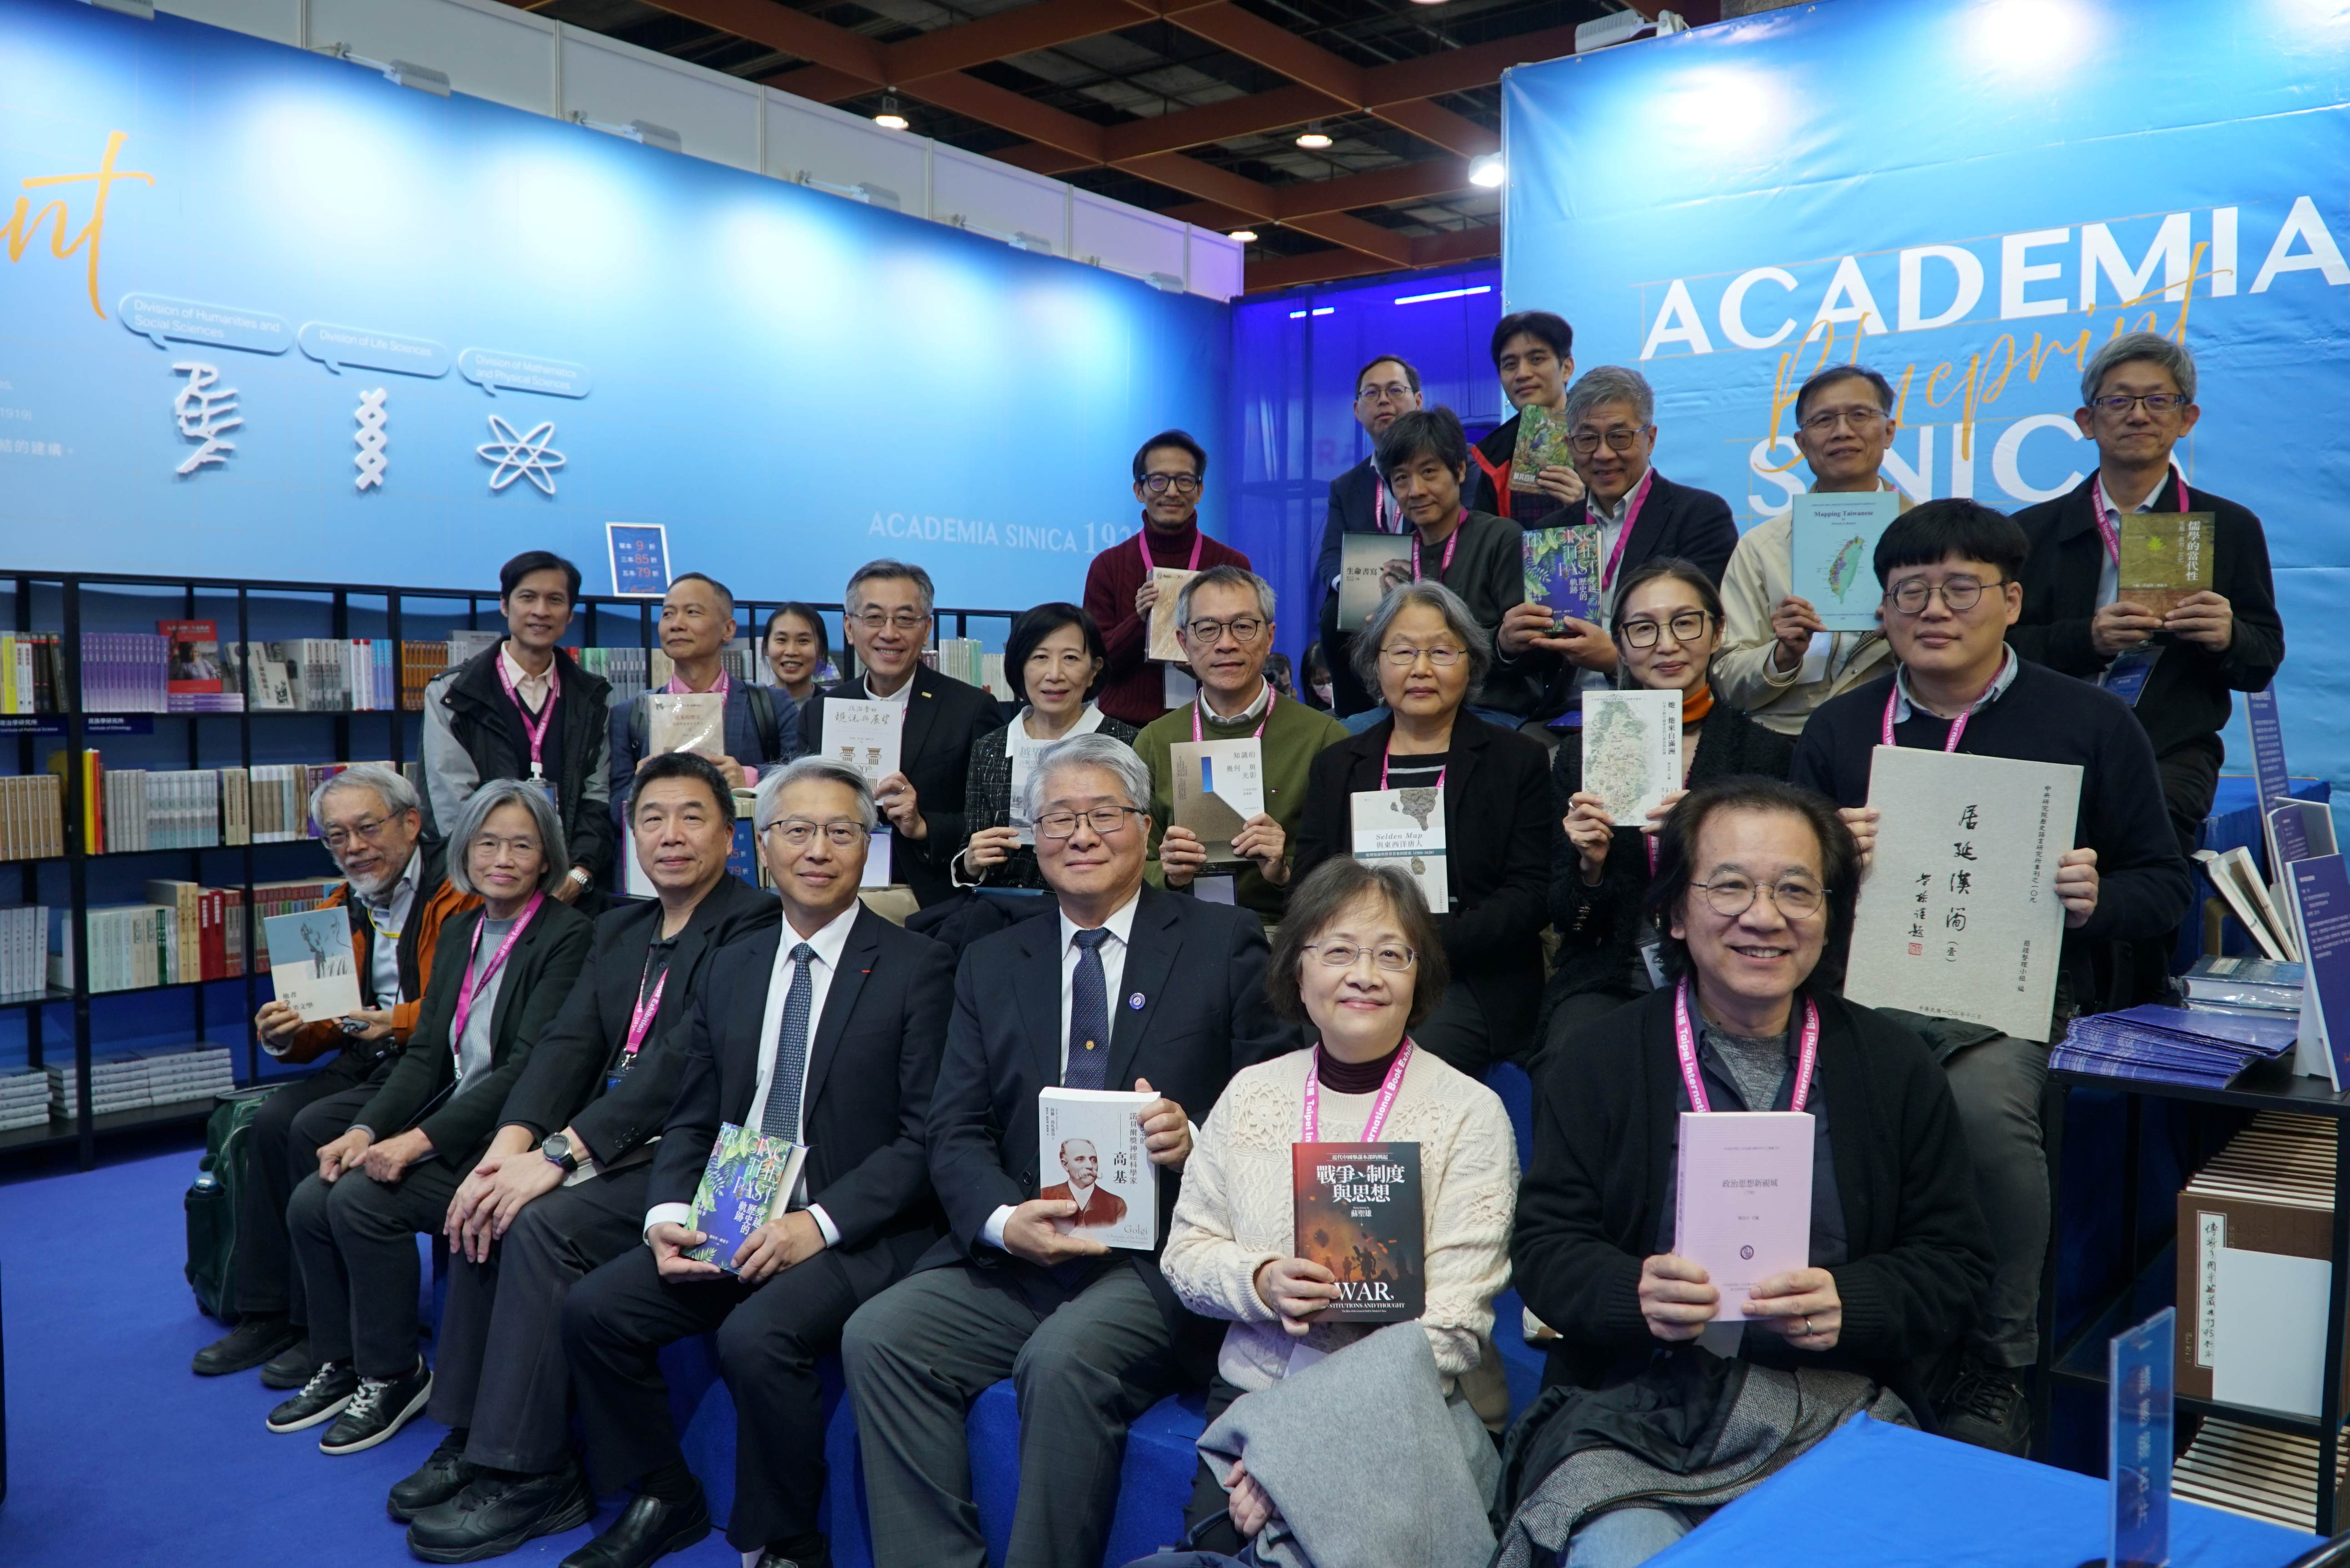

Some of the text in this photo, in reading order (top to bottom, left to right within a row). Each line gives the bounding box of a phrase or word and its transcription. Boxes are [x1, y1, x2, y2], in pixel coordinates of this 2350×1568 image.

[1640, 196, 2350, 361] ACADEMIA
[134, 299, 280, 332] Division of Humanities and
[134, 315, 225, 338] Social Sciences
[319, 329, 432, 357] Division of Life Sciences
[475, 354, 510, 368] Division
[522, 361, 577, 379] Mathematics
[476, 368, 571, 390] and Physical Sciences
[1749, 414, 2190, 517] SNIC
[868, 511, 999, 546] ACADEMIA
[1005, 523, 1078, 553] SINICA
[1523, 526, 1597, 548] TRACING
[636, 540, 644, 551] 9
[1563, 543, 1597, 560] THE
[2186, 521, 2200, 581] 儒學的當代性
[634, 553, 650, 564] 85
[1558, 559, 1597, 577] PAST
[636, 567, 652, 578] 79
[1346, 567, 1379, 576] 生命書寫
[1569, 578, 1578, 595] 軌跡
[1578, 577, 1587, 601] 歷史的
[1233, 750, 1256, 759] 知識的
[1226, 764, 1241, 773] 幾何
[1242, 771, 1257, 779] 光影
[1376, 839, 1423, 849] 與東西洋唐人
[502, 933, 516, 950] Book
[512, 910, 532, 937] Exhibition
[636, 996, 659, 1034] Exhibition
[1679, 1026, 1693, 1061] Taipei
[1386, 1067, 1403, 1091] Book
[1798, 1031, 1816, 1106] International
[1304, 1099, 1315, 1131] Taipei
[718, 1125, 788, 1163] TRACING
[1129, 1112, 1138, 1185] 諾貝爾獎神經科學家
[748, 1157, 782, 1185] THE
[1113, 1151, 1128, 1185] 高基
[1316, 1164, 1406, 1184] 戰爭、制度
[732, 1175, 776, 1205] PAST
[1332, 1183, 1391, 1203] 與思想
[733, 1200, 748, 1222] 軌跡
[739, 1203, 758, 1236] 歷史的
[751, 1206, 767, 1228] 穿越
[1351, 1209, 1372, 1218] 蘇聖雄
[1124, 1224, 1148, 1236] Golgi
[1333, 1282, 1395, 1302] WAR,
